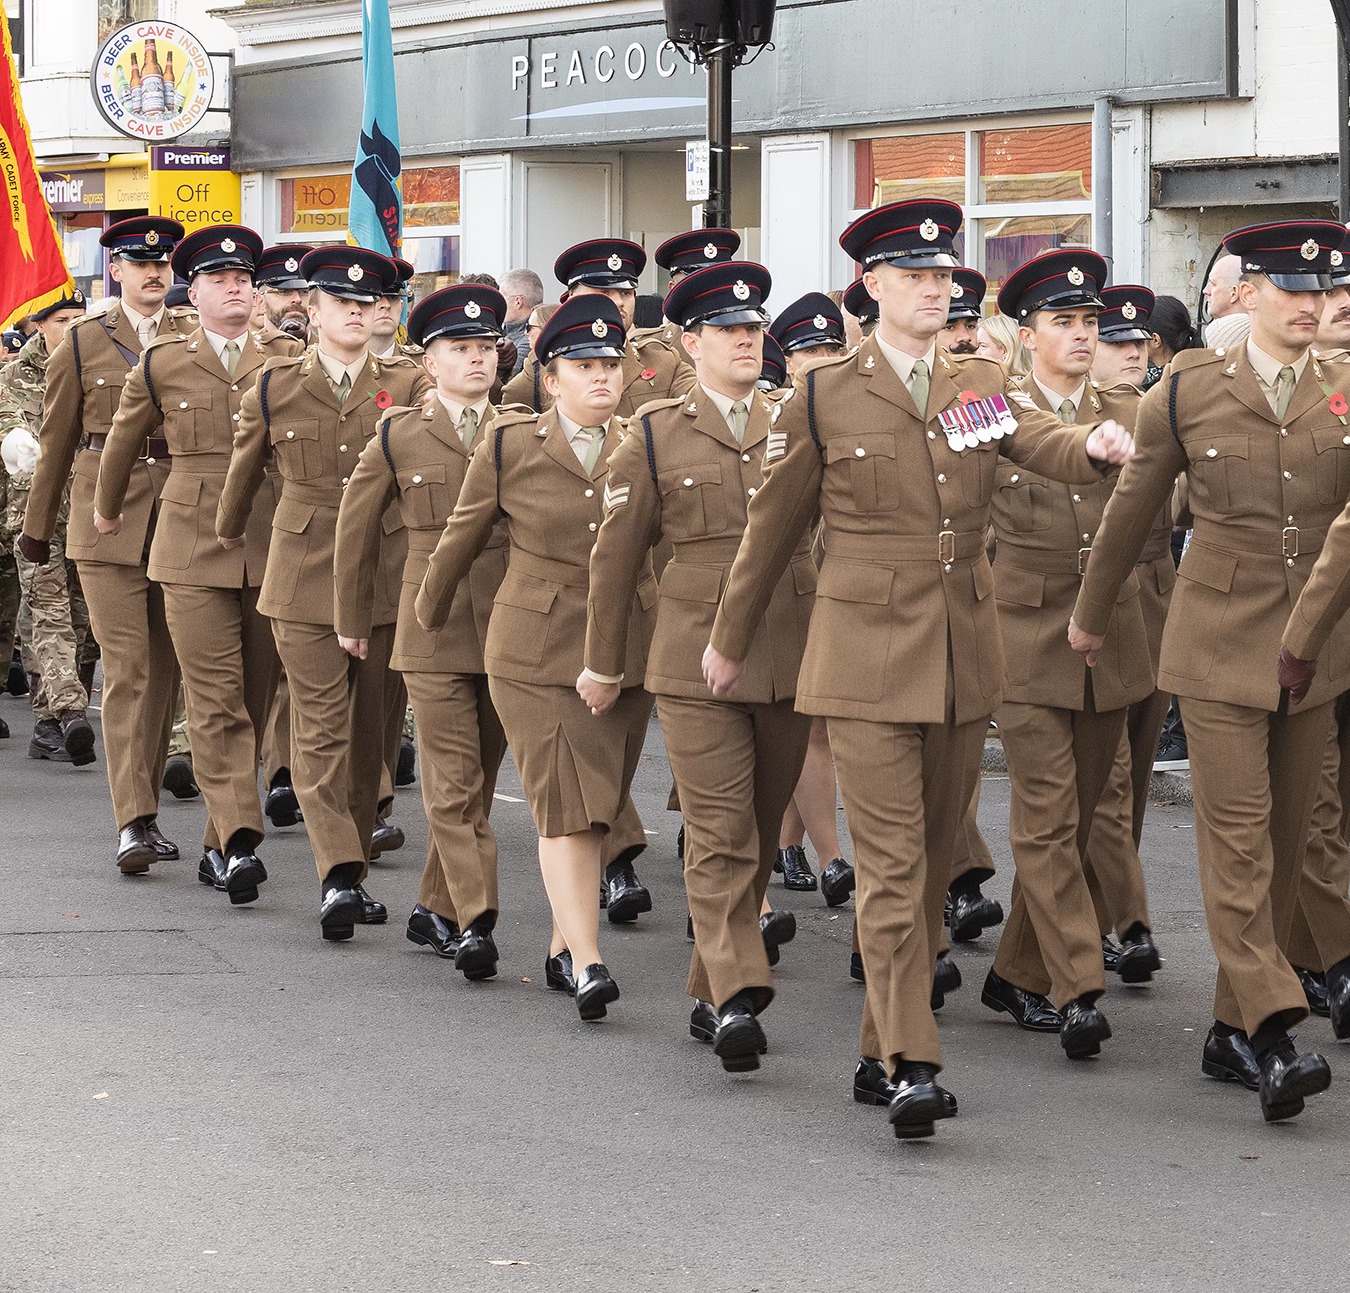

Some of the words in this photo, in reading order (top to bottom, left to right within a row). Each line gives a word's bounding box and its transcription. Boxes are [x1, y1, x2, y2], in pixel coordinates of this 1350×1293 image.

[104, 34, 132, 66] BEER
[137, 26, 174, 39] CAVE
[178, 35, 208, 77] INSIDE
[101, 84, 124, 120] BEER
[127, 119, 163, 136] CAVE
[170, 95, 206, 133] INSIDE
[0, 138, 10, 160] RMY
[5, 163, 17, 191] CADET
[164, 151, 225, 165] Premier
[42, 178, 84, 204] remier
[83, 193, 104, 209] express
[176, 184, 210, 203] Off
[159, 205, 233, 223] Licence
